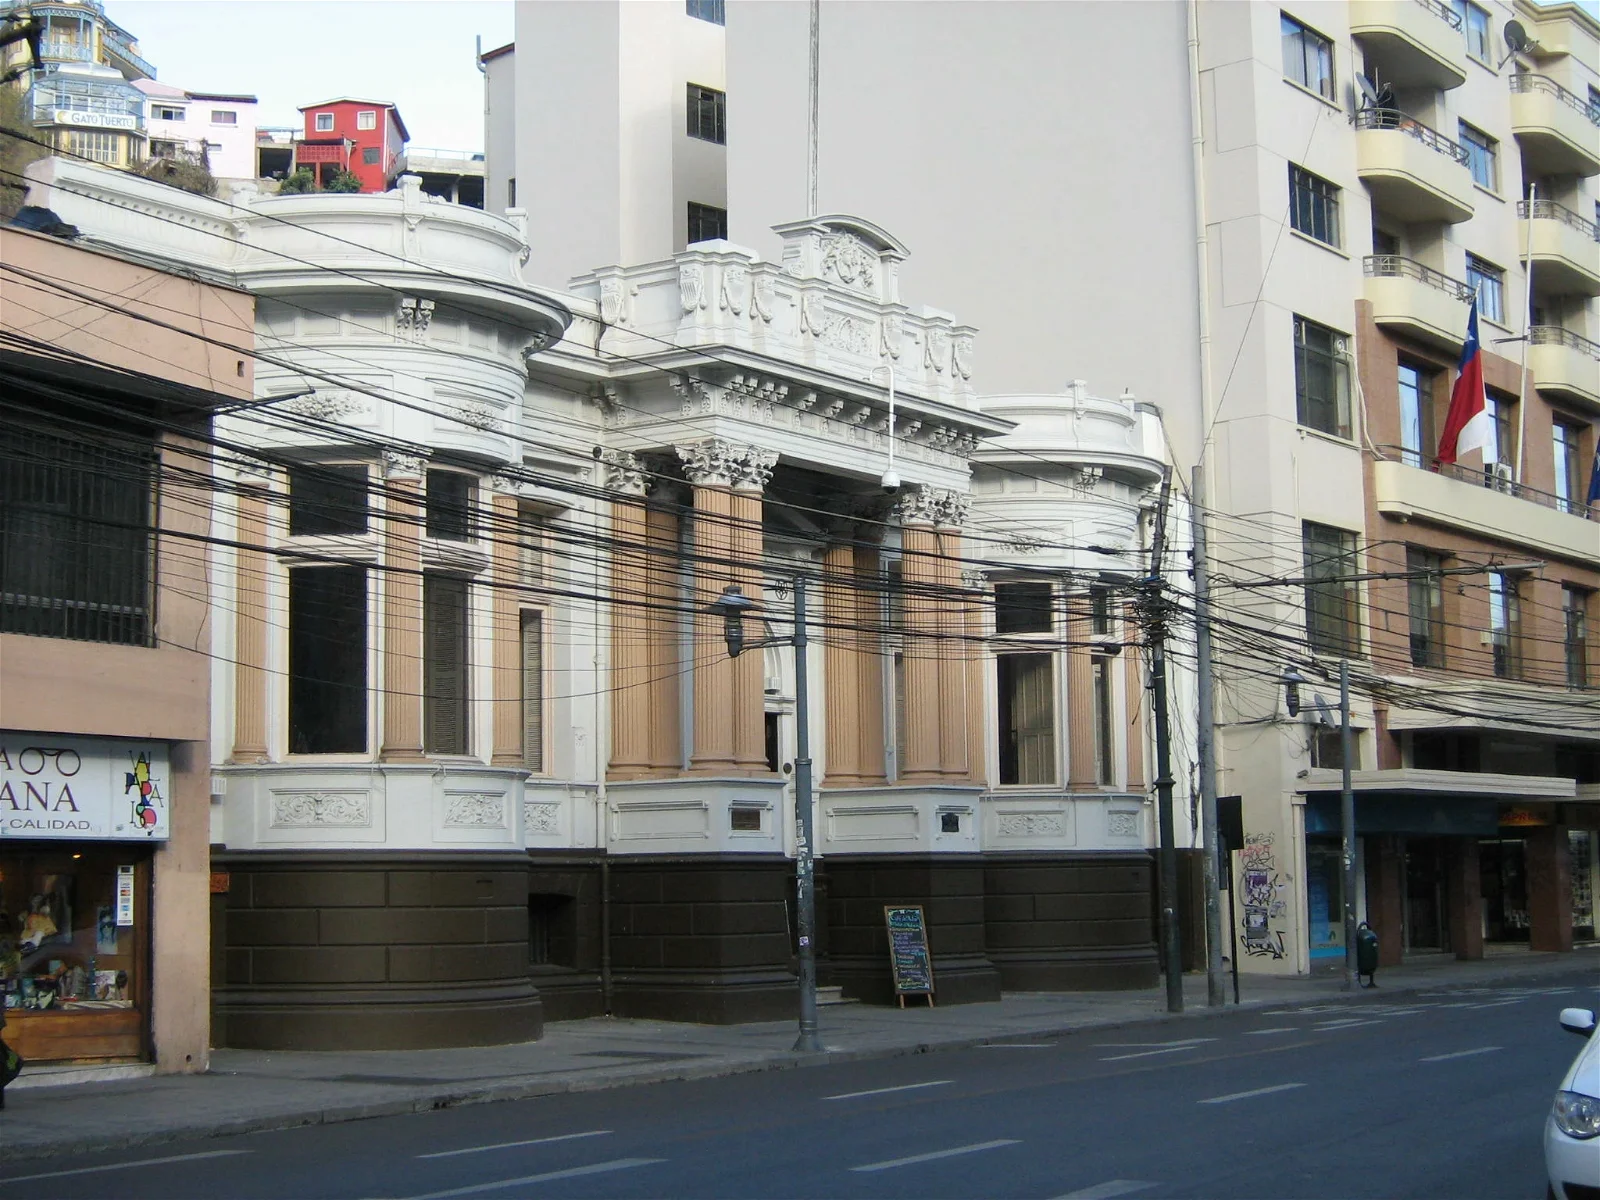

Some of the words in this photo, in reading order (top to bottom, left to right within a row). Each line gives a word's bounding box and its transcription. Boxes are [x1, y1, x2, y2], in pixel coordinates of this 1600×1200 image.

[71, 112, 98, 125] GATO
[99, 114, 134, 127] TUERTO
[9, 818, 90, 830] CALIDAD
